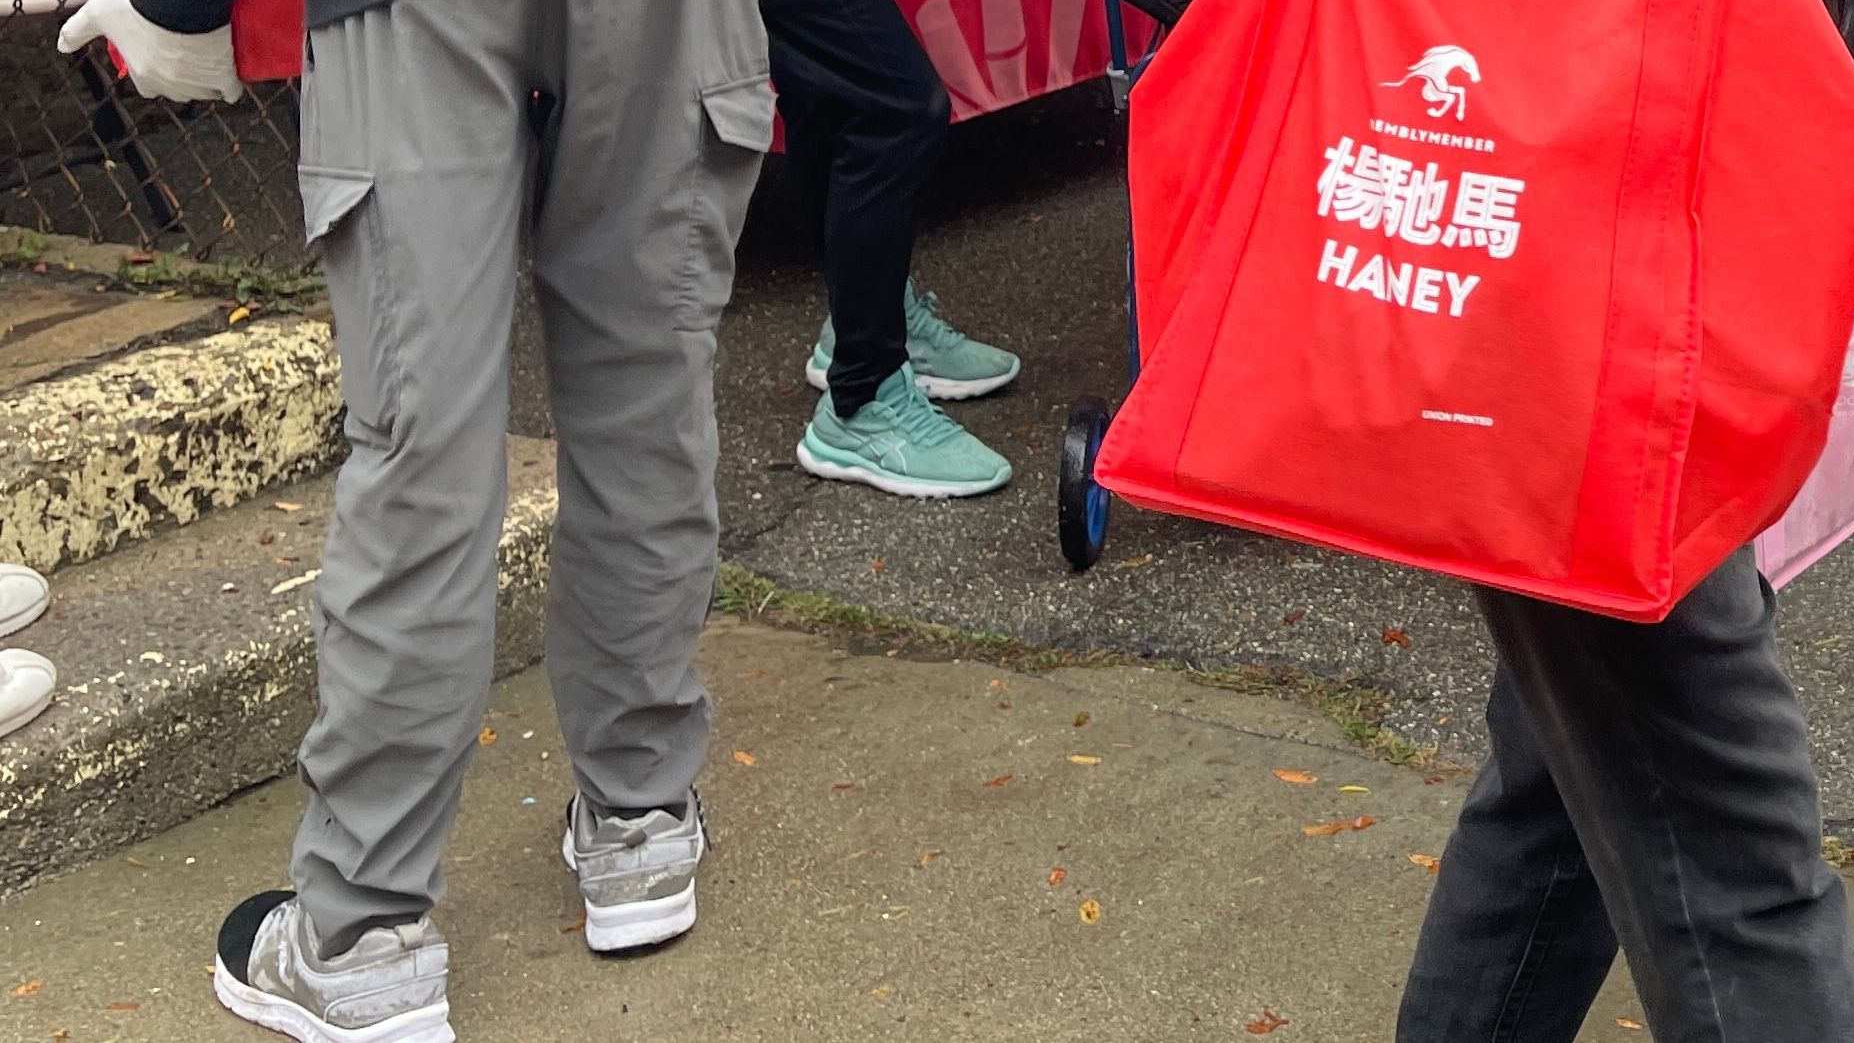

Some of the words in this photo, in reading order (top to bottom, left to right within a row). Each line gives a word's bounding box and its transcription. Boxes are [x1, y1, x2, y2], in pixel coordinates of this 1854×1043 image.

[1317, 135, 1526, 259] 楊馳馬
[1317, 239, 1481, 317] HANEY
